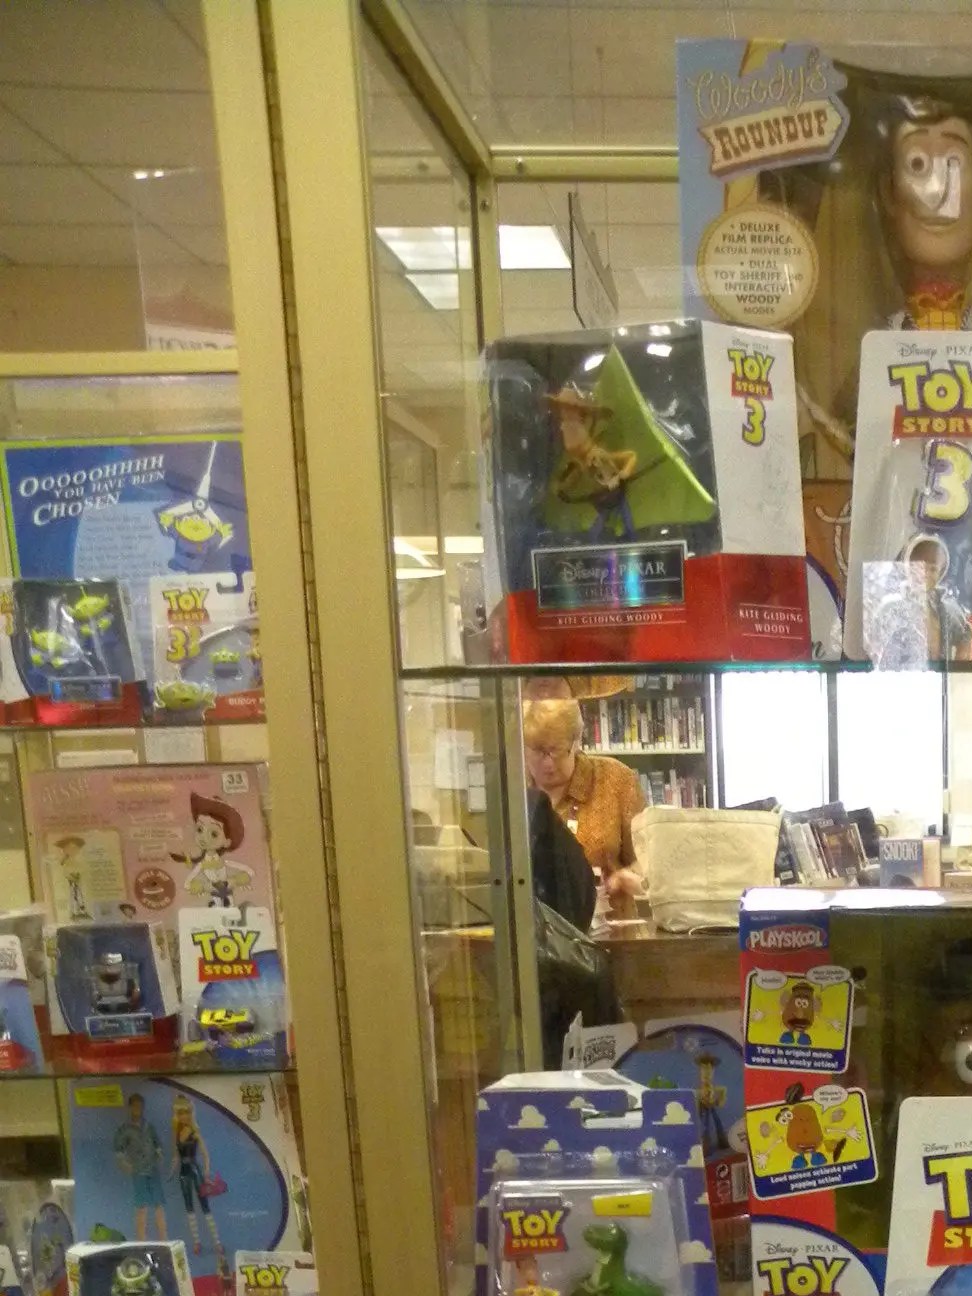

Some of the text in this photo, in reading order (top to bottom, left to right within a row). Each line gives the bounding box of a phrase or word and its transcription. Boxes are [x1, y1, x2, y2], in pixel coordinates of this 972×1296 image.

[713, 108, 829, 162] ROUNDUP
[739, 222, 781, 233] DELUXE
[722, 234, 794, 245] FILM REPLICA
[714, 246, 748, 256] ACTUAL
[714, 270, 736, 281] TOY
[735, 294, 783, 305] WOODY
[897, 341, 938, 359] Disney
[727, 348, 776, 382] TOY
[741, 396, 767, 448] 3
[91, 479, 126, 494] HAVE
[132, 471, 166, 486] BEEN
[33, 491, 122, 527] CHOSEN
[162, 587, 209, 611] TOY
[581, 614, 622, 625] GLIDING
[626, 612, 665, 623] WOODY
[763, 611, 805, 623] GLIDING
[754, 622, 792, 635] WOODY
[227, 773, 244, 785] 33
[190, 928, 261, 964] TOY
[749, 928, 825, 950] PLAYSKOOL
[203, 962, 254, 976] STORY
[501, 1208, 567, 1238] TOY
[511, 1238, 560, 1249] STORY
[762, 1242, 839, 1257] Disney PIXAR
[238, 1262, 290, 1292] TOY
